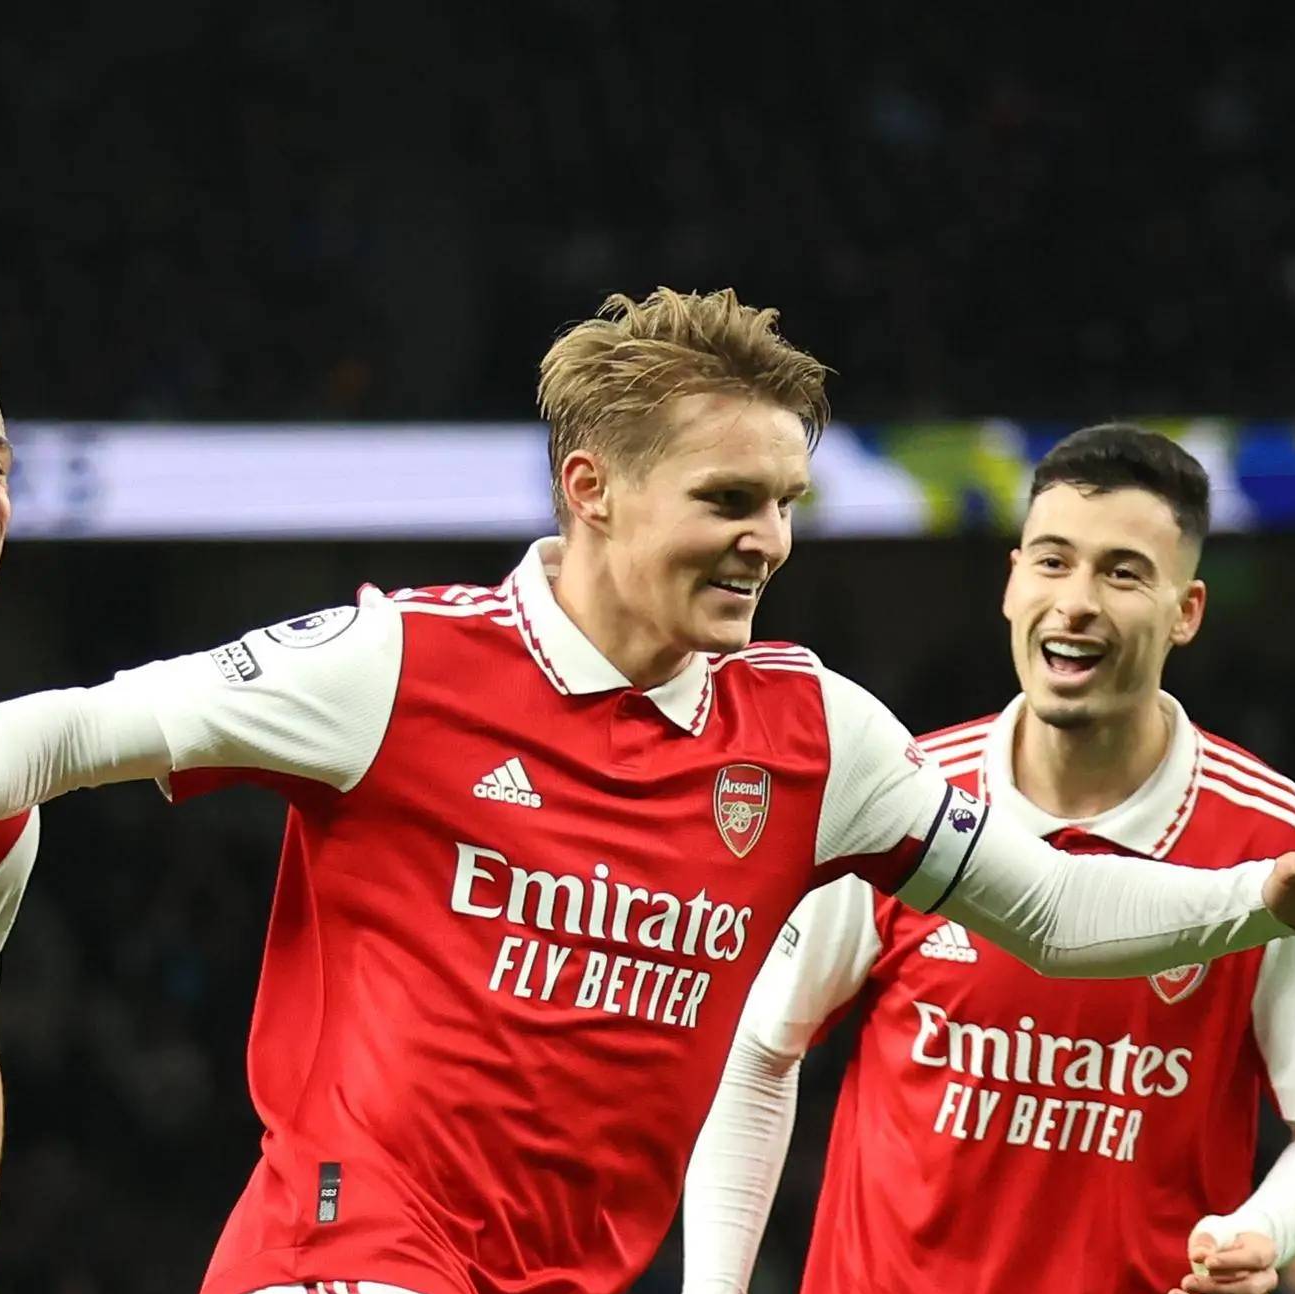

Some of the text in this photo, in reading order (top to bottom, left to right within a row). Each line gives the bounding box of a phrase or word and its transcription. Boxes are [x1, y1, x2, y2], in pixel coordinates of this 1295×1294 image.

[473, 782, 543, 809] adidas
[720, 777, 763, 797] Arsenal
[449, 841, 753, 962] Emirates
[488, 936, 711, 1029] FLY BETTER
[919, 941, 978, 964] adidas
[910, 1000, 1193, 1098] Emirates
[933, 1081, 1144, 1162] FLY BETTER
